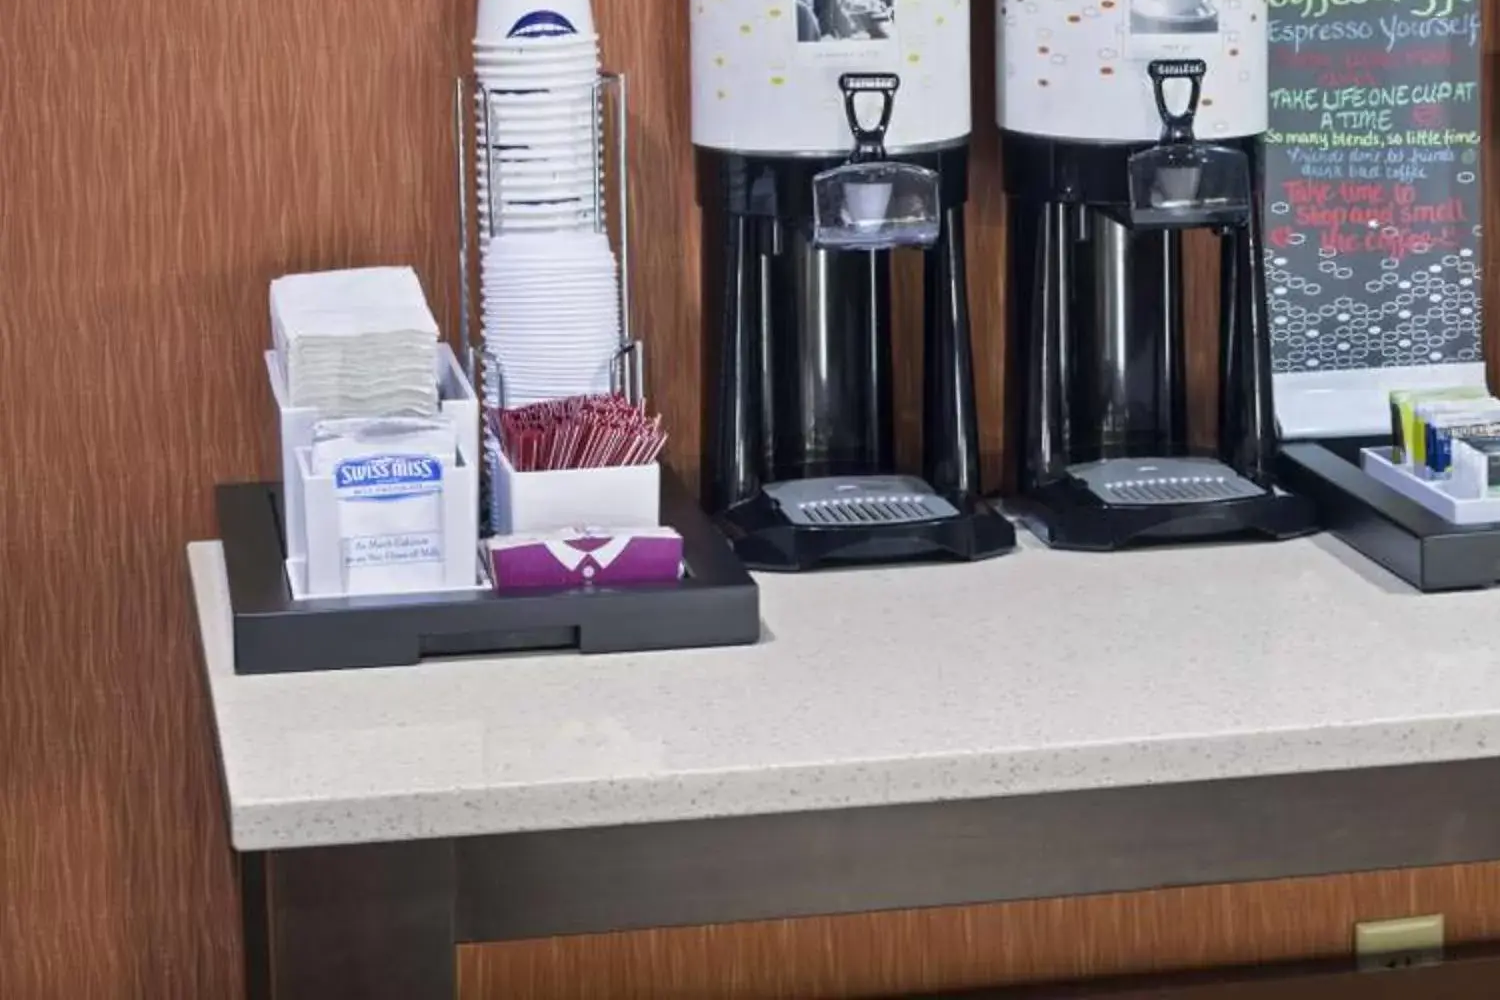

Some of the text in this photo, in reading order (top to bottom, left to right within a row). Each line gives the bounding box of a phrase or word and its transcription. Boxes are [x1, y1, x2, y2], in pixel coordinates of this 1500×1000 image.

[1267, 19, 1374, 53] Espresso
[1269, 80, 1477, 110] TAKE LIFE ONE CUP AT
[1320, 108, 1394, 131] A TIME
[1264, 127, 1283, 144] So
[1286, 130, 1328, 151] many
[1332, 129, 1384, 149] blends,
[1387, 131, 1402, 144] so
[1406, 128, 1442, 146] little
